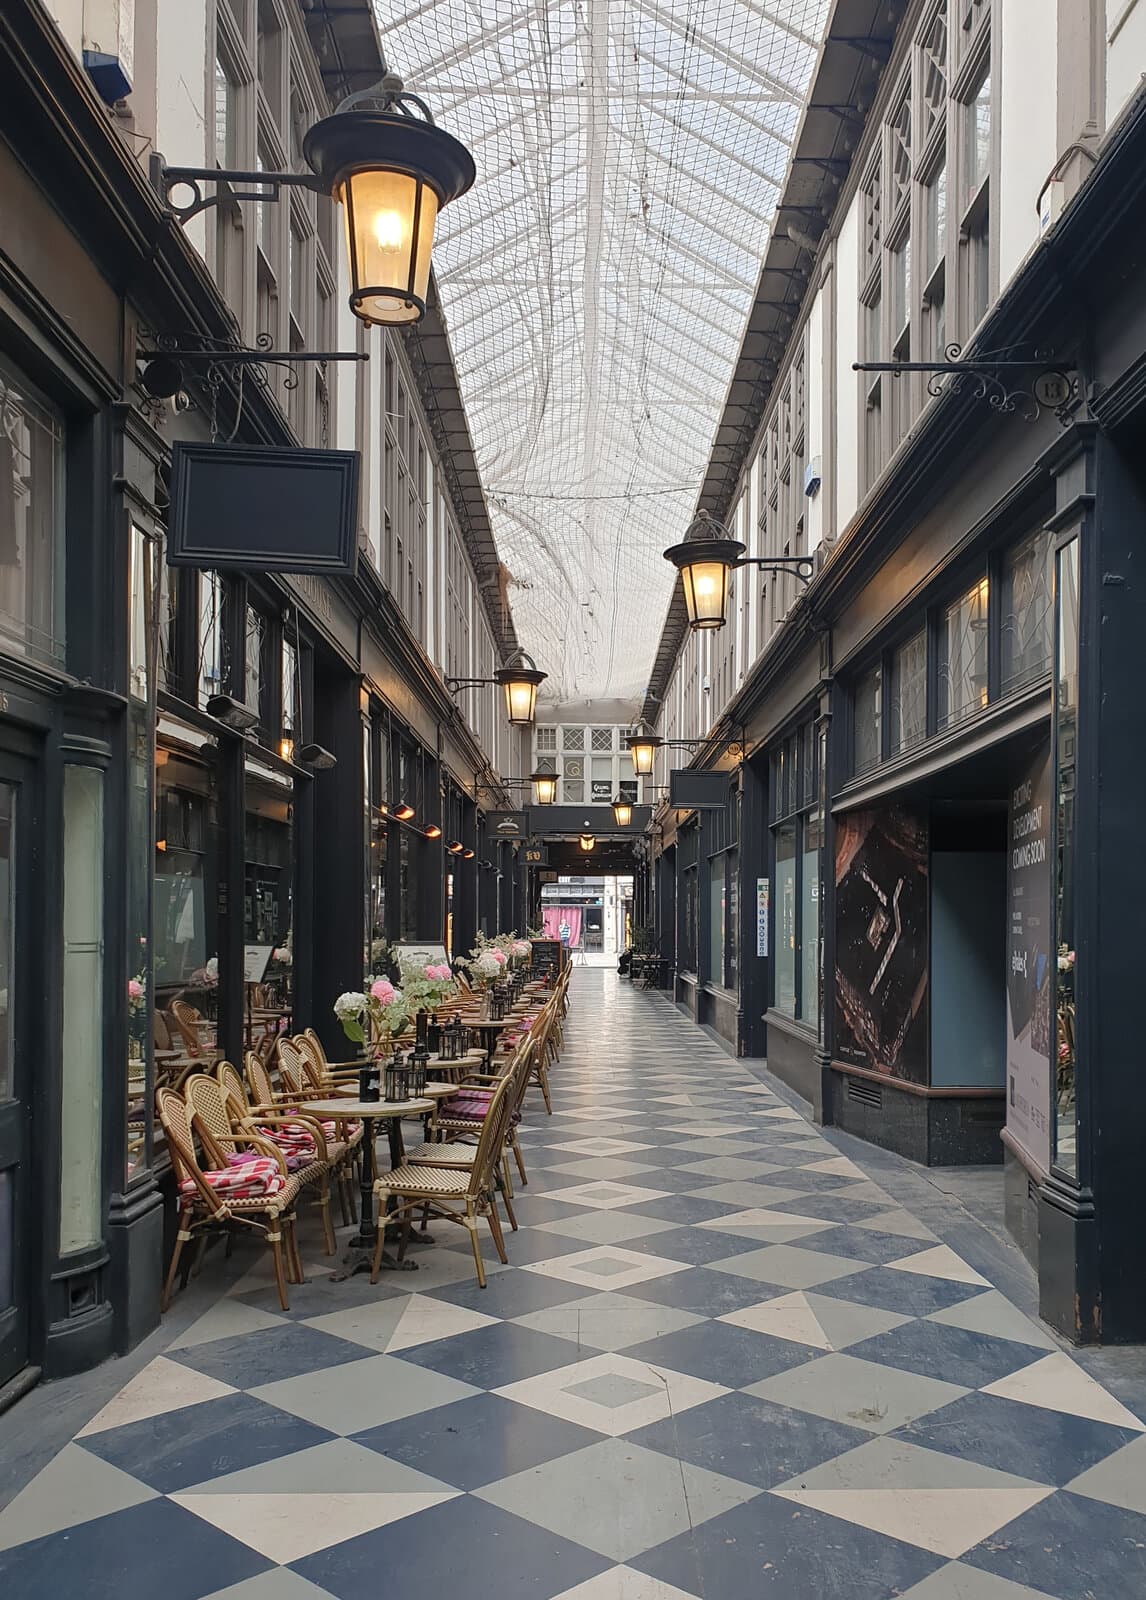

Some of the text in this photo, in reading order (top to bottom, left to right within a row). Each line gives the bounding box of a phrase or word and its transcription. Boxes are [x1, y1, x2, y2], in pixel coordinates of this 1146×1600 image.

[1013, 805, 1043, 840] DEVELOPMENT
[1012, 838, 1046, 869] COMING SOON
